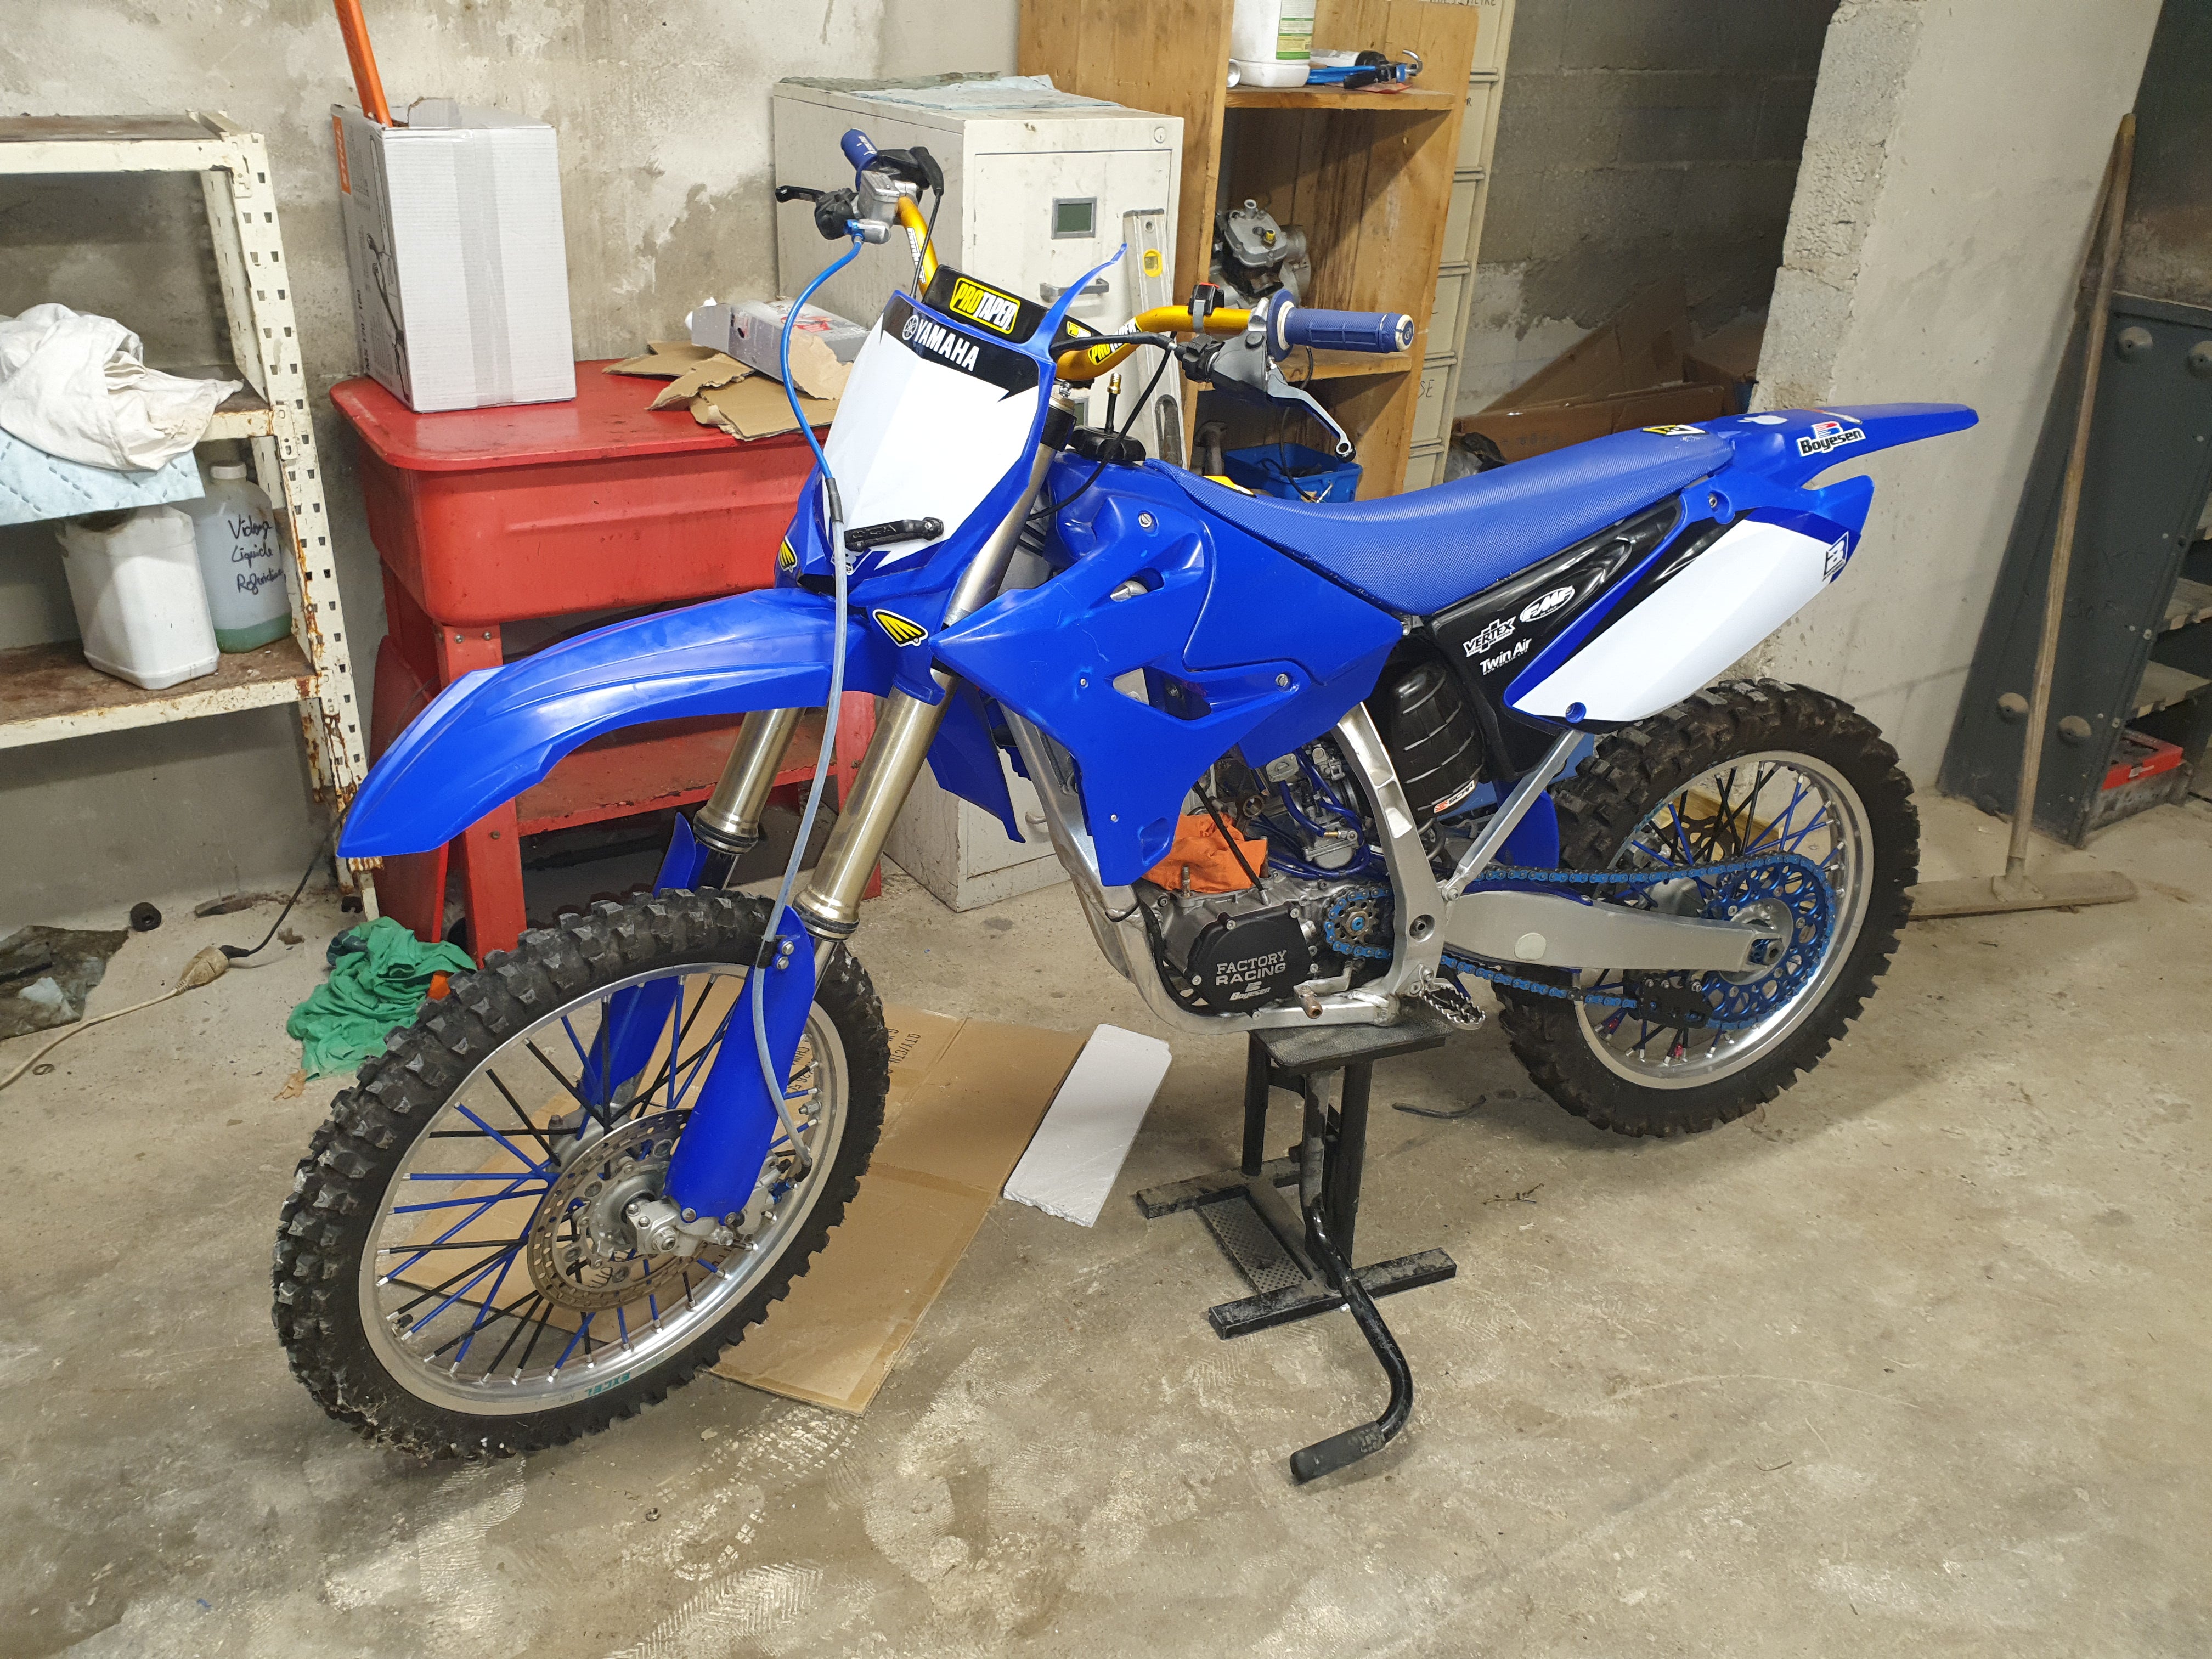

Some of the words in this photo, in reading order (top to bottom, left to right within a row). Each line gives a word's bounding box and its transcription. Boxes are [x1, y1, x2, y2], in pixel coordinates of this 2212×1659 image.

[913, 319, 980, 372] YAMAHA
[1799, 430, 1863, 454] Boyesen
[1521, 585, 1573, 623] FMF
[1465, 619, 1514, 652] VERTEX
[1479, 651, 1511, 674] Twin
[1513, 637, 1532, 657] Air
[1448, 782, 1474, 804] SCAR
[1215, 962, 1286, 986] RACING
[1216, 949, 1288, 975] FACTORY
